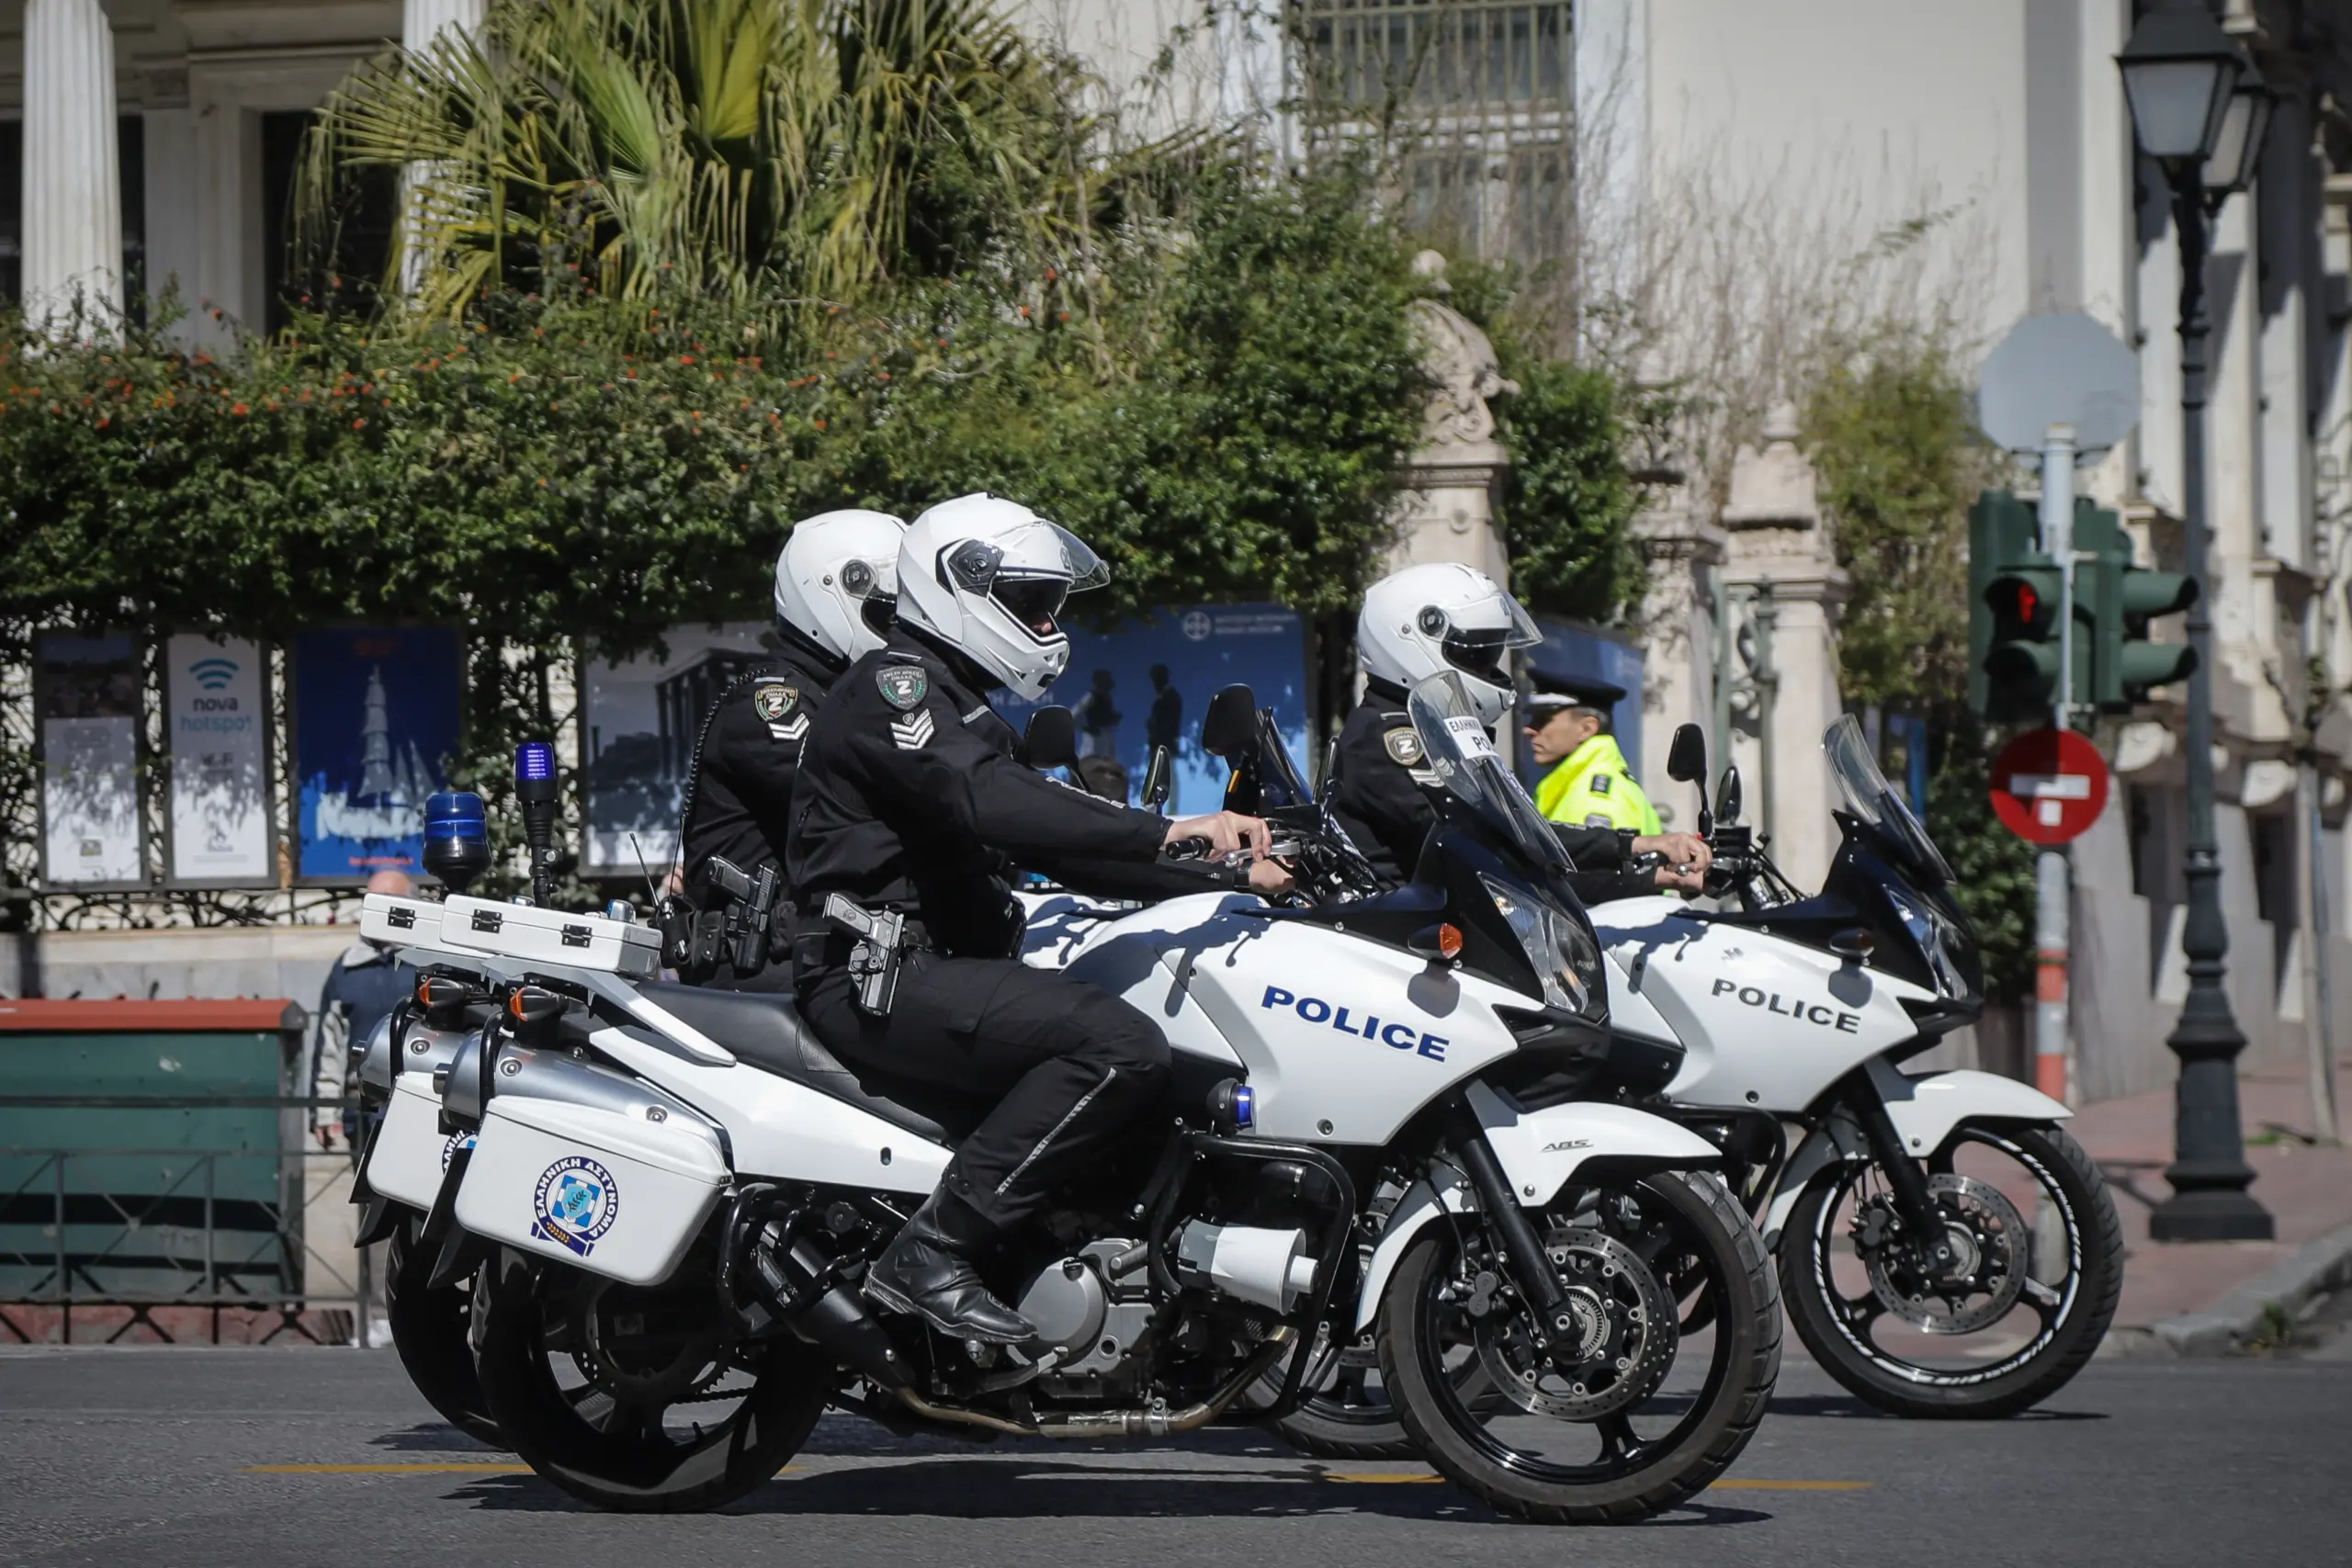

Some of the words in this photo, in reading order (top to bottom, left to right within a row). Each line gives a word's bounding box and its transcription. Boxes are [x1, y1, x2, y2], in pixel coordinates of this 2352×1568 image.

[193, 697, 238, 712] nova
[180, 714, 252, 734] hotspot
[1261, 985, 1450, 1063] POLICE
[1712, 978, 1860, 1034] POLICE
[1542, 1138, 1590, 1153] ABS
[536, 1157, 581, 1219] ΕΛΛΗΝΙΚΗ
[584, 1161, 616, 1238] ΑΣΤΥΝΟΜΙΑ
